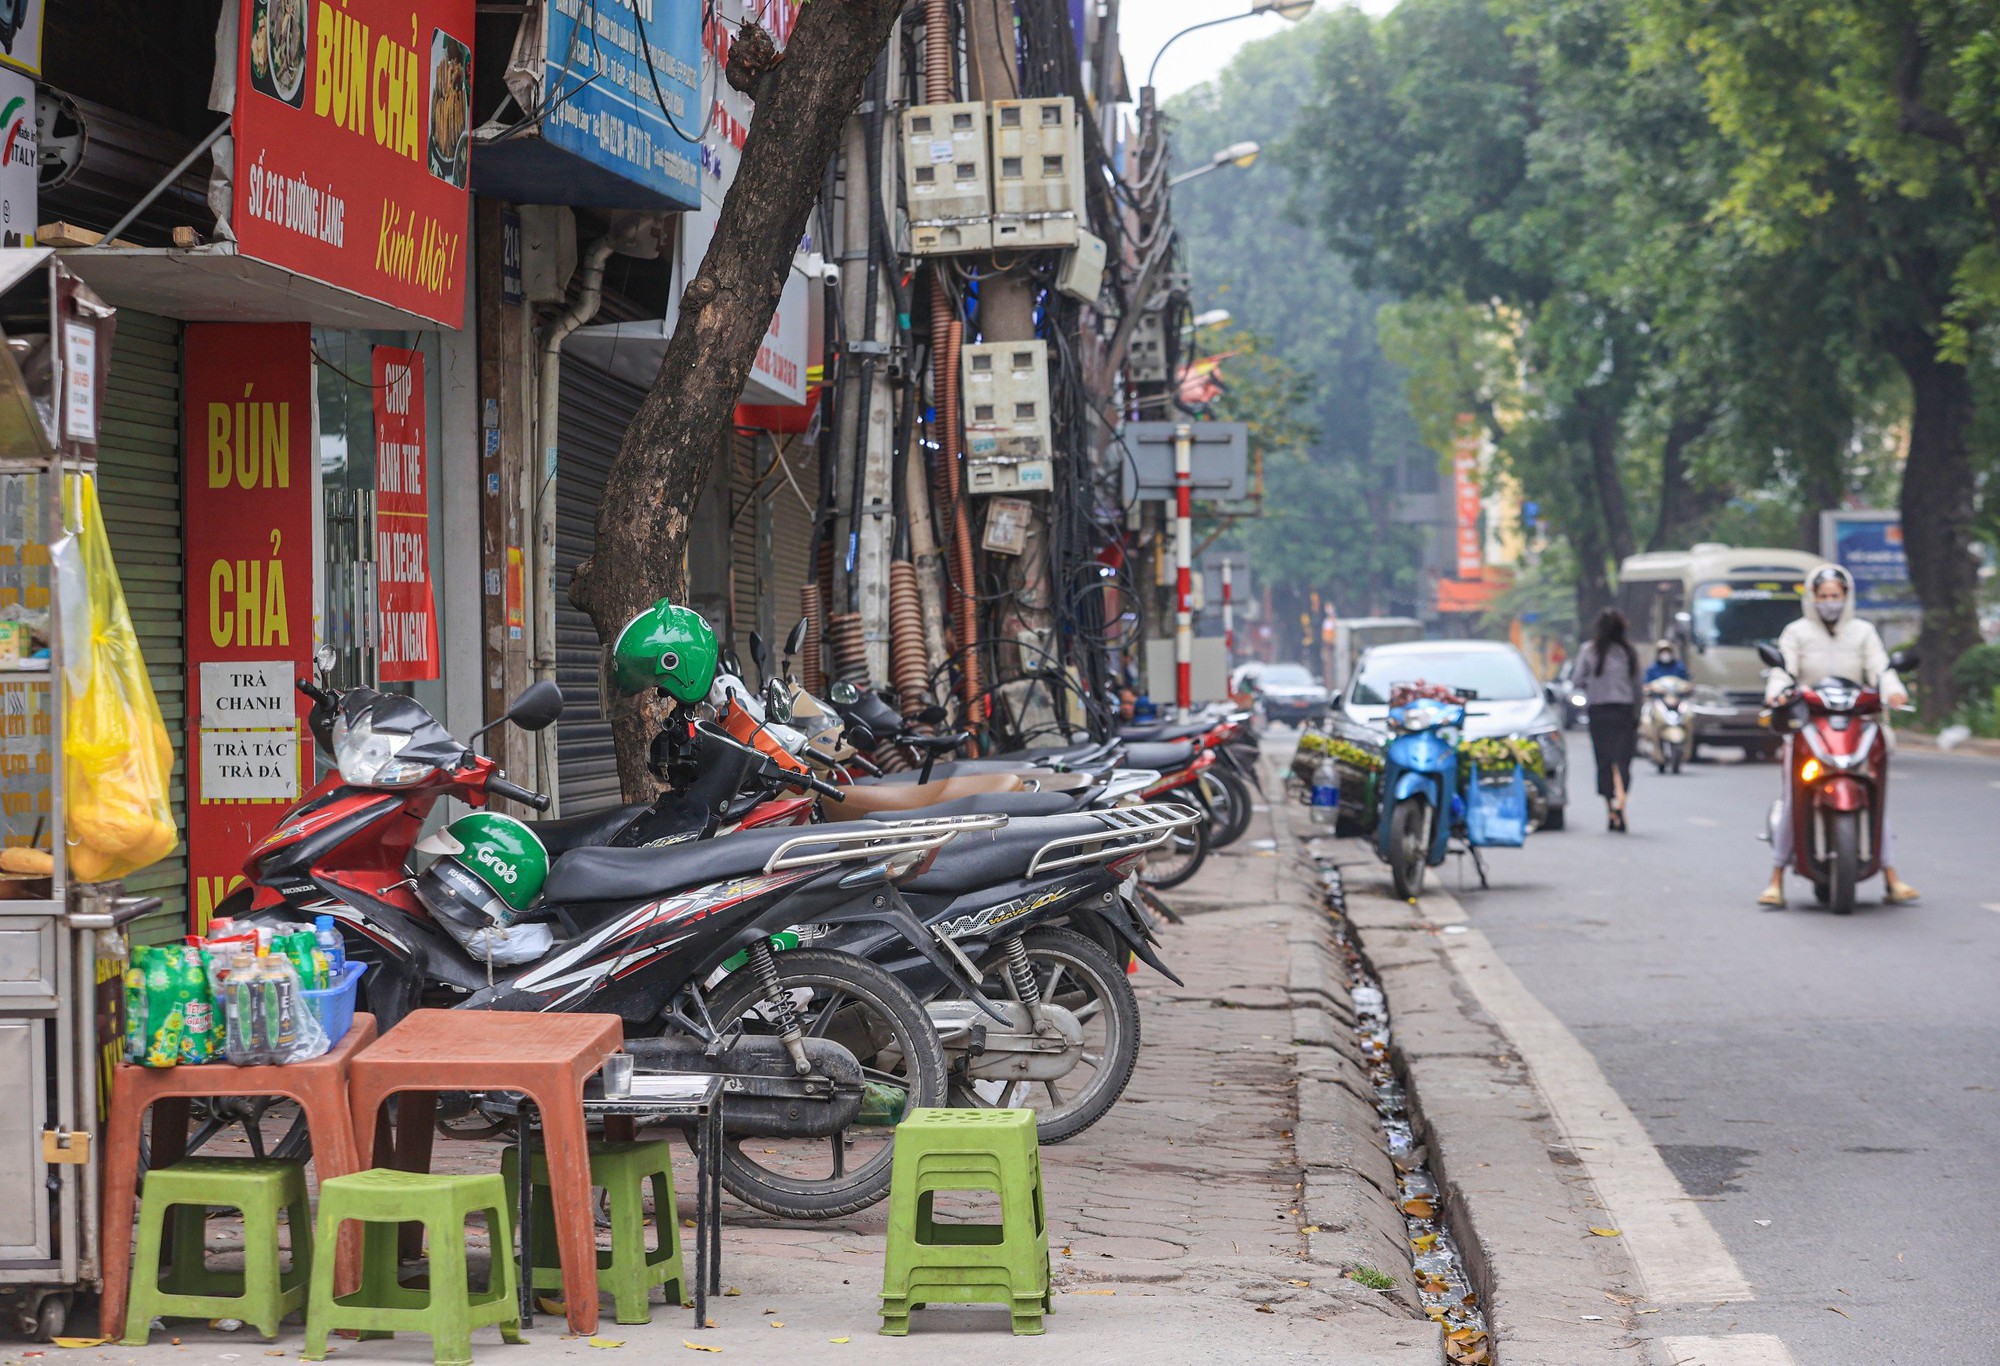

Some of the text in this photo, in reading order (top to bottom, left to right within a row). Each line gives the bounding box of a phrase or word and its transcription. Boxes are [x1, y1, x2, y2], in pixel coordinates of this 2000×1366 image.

[315, 0, 418, 162] BÚN CHẢ
[11, 143, 36, 168] ITALY
[249, 148, 345, 248] SỐ 216 ĐƯỜNG LÁNG
[375, 198, 415, 286] Kính
[504, 223, 520, 269] 214
[385, 362, 412, 427] CHỤP
[208, 383, 290, 490] BÚN
[379, 424, 421, 495] ẢNH THẺ
[379, 531, 424, 583] IN DECAL
[209, 528, 290, 648] CHẢ
[380, 593, 428, 663] LẤY NGAY
[216, 696, 281, 710] CHANH
[230, 670, 267, 687] TRÀ
[213, 740, 248, 756] TRÀ
[218, 760, 281, 778] TRÀ ĐÁ
[281, 884, 318, 895] HONDA
[477, 846, 518, 884] Grab
